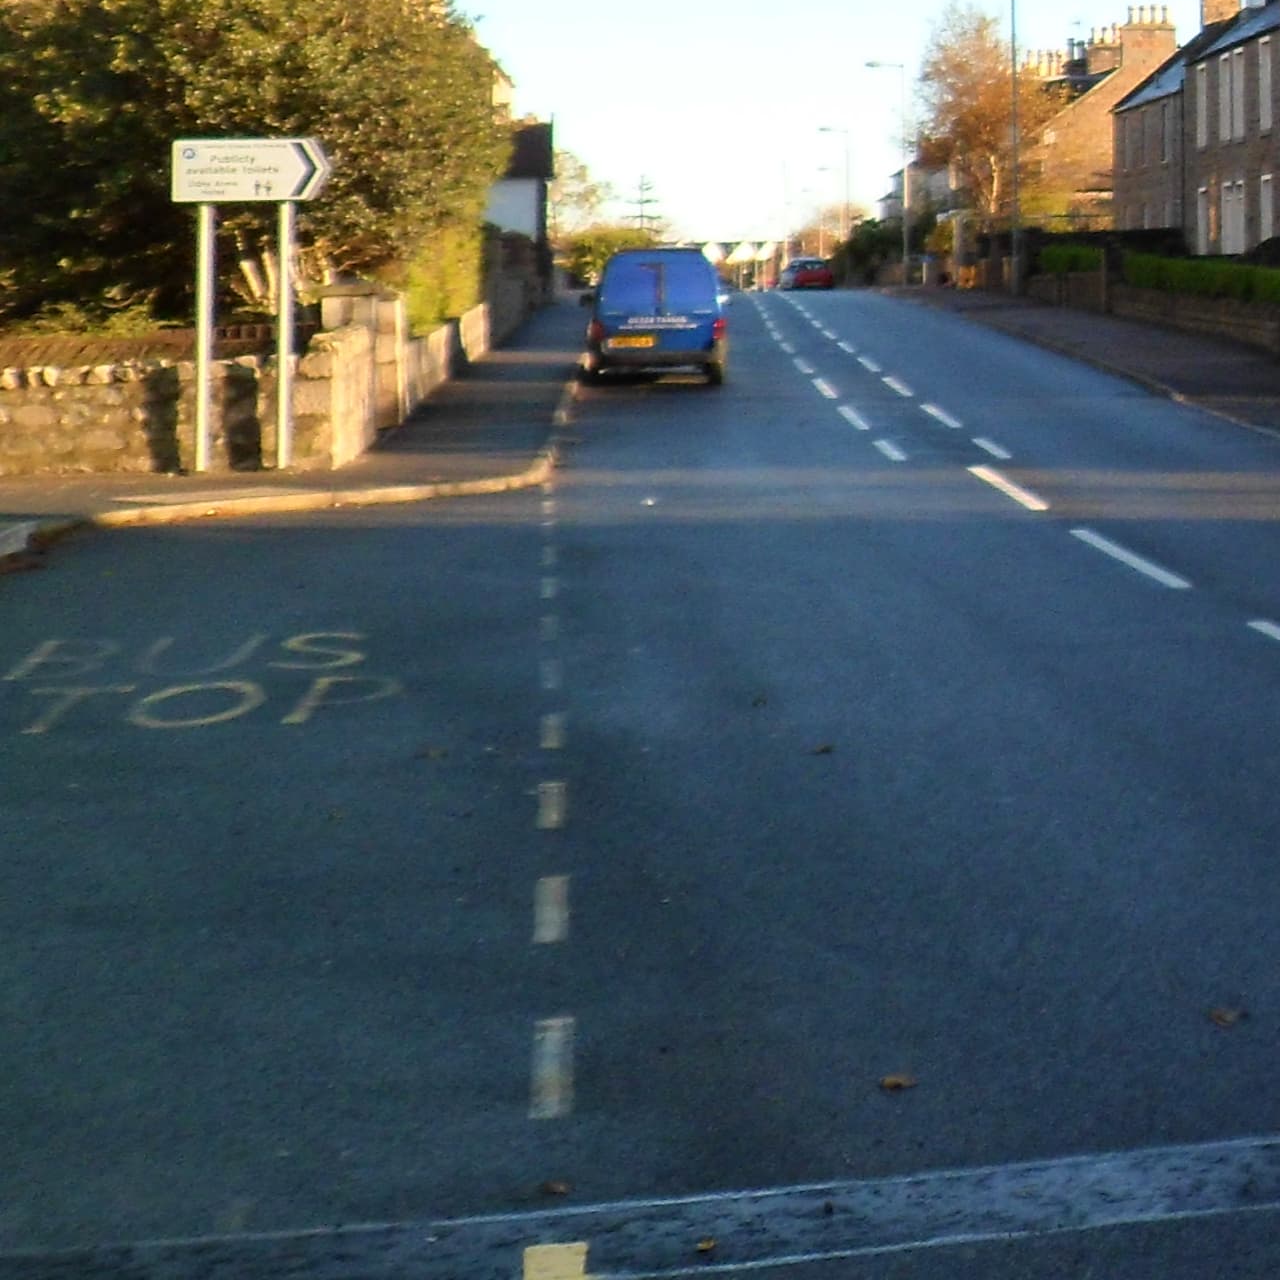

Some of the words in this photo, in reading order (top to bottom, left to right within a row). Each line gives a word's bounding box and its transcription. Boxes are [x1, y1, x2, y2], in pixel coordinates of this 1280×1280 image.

[186, 166, 237, 175] available
[2, 631, 371, 681] BUS
[21, 676, 405, 734] TOP
